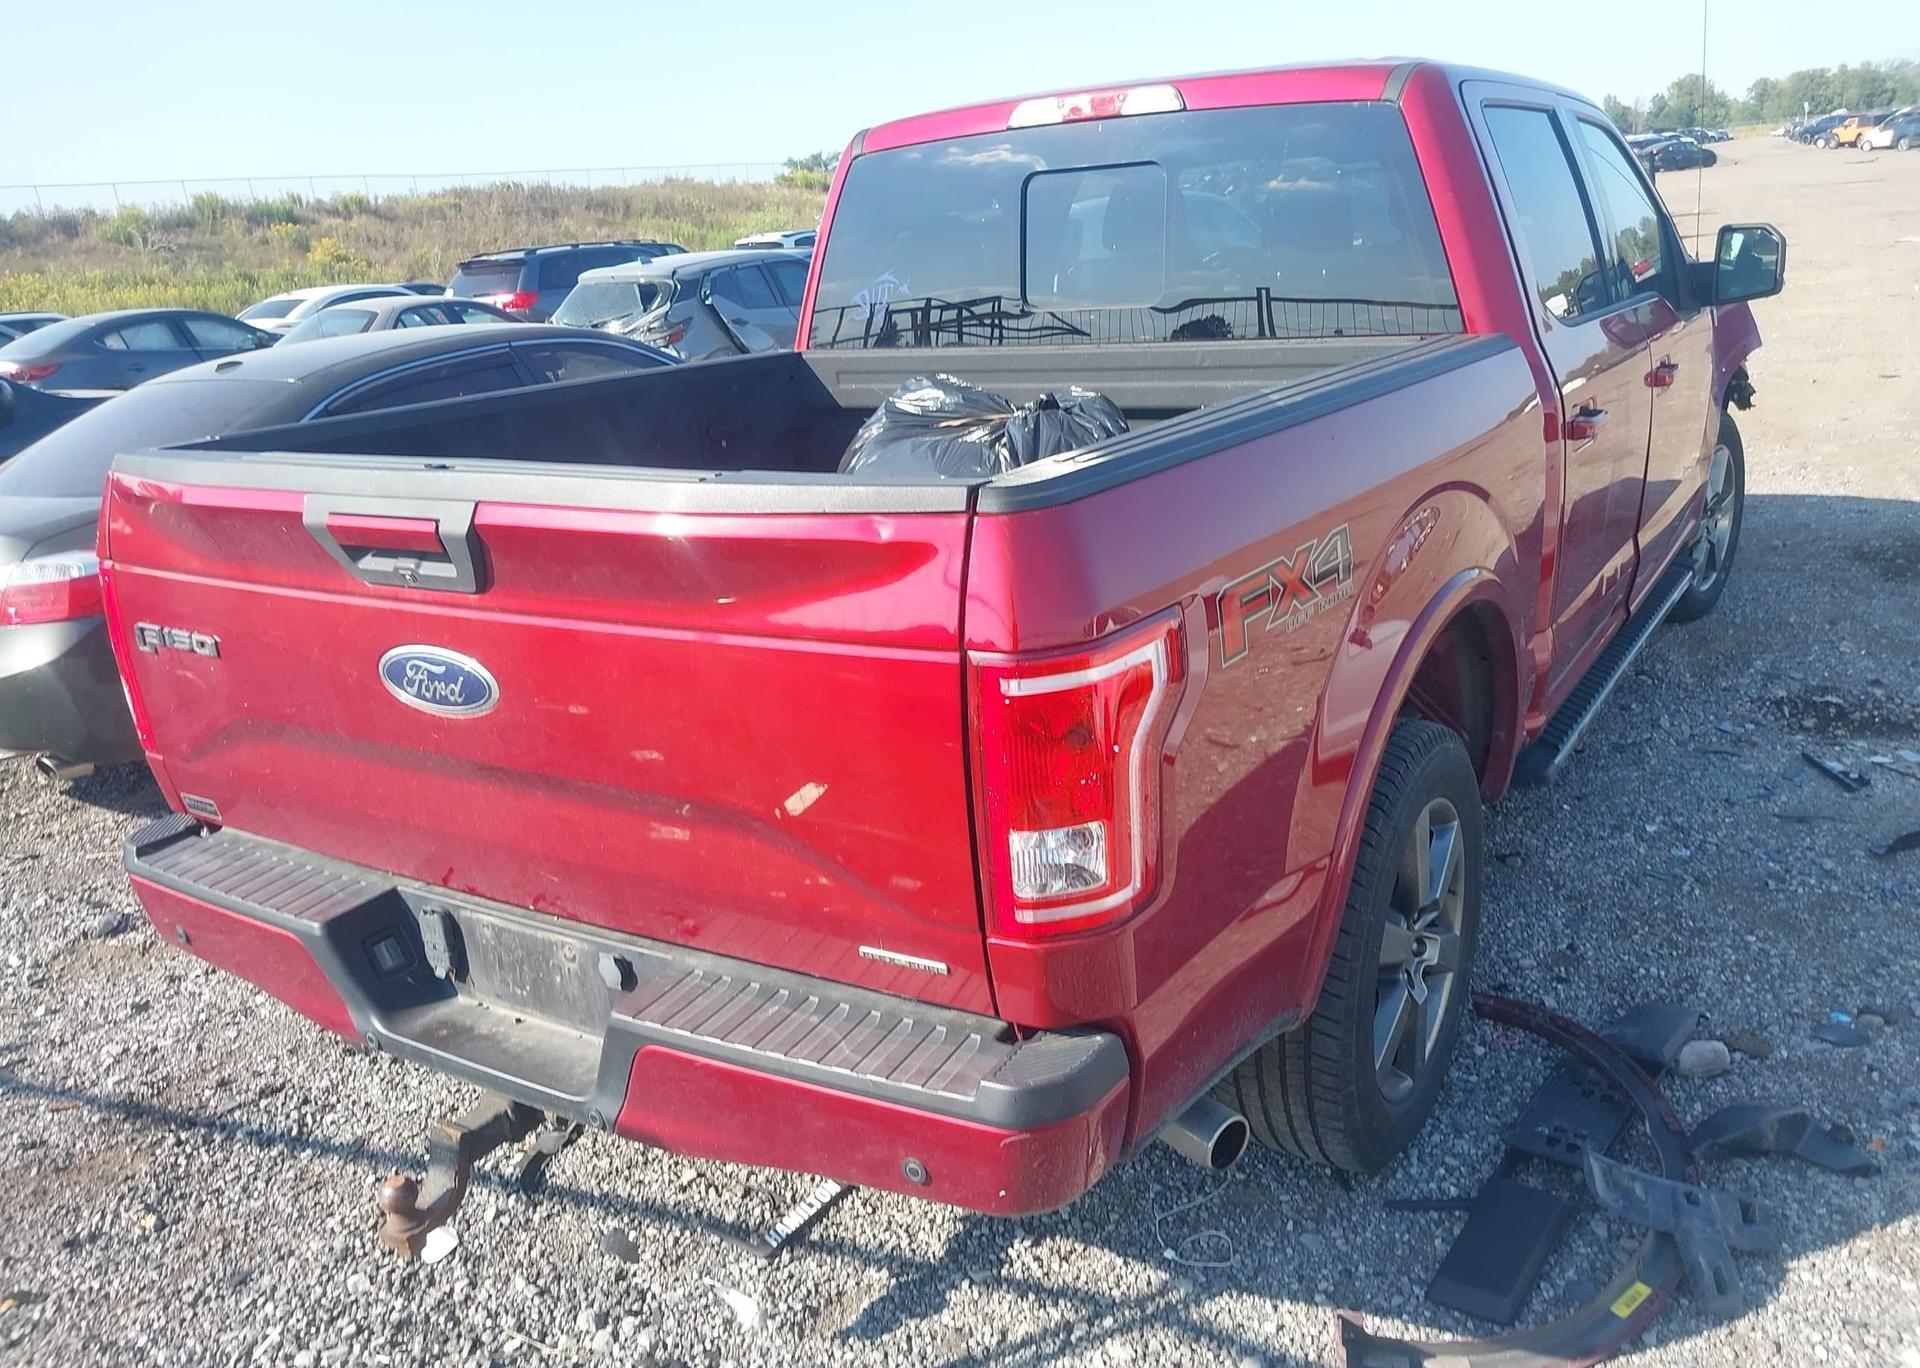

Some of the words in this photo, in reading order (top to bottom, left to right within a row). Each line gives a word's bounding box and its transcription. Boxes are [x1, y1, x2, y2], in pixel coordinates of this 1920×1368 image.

[1216, 524, 1353, 668] FX4
[403, 659, 465, 704] Ford
[765, 1178, 842, 1248] HAMILTON
